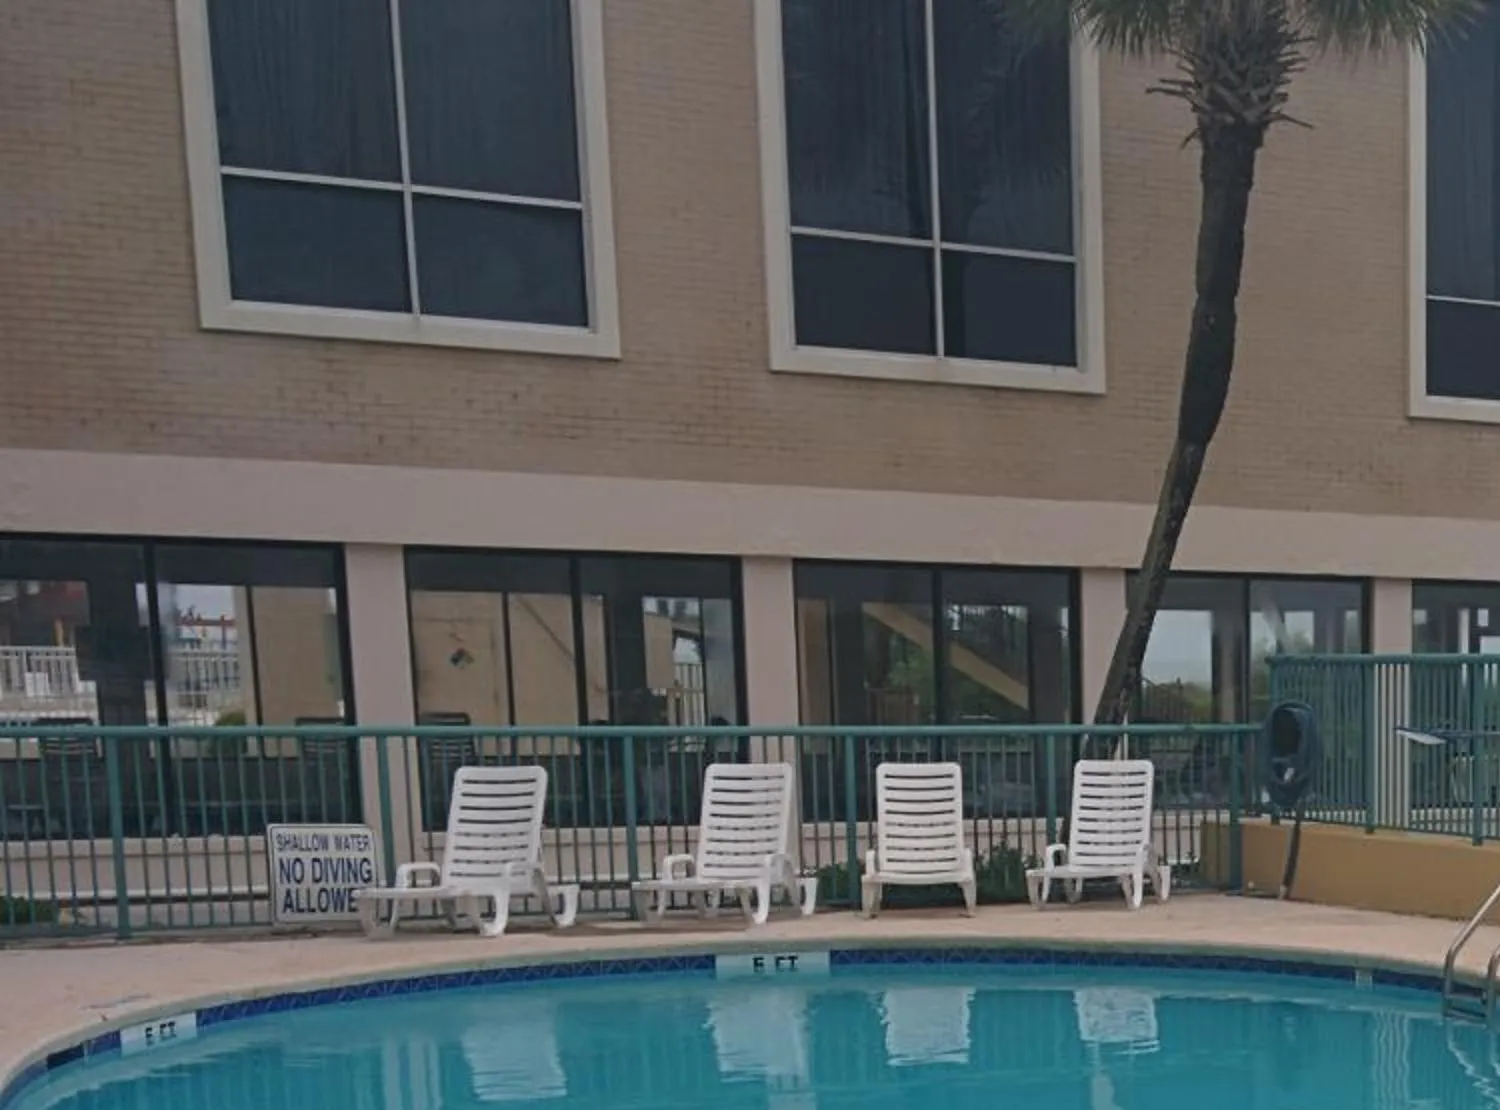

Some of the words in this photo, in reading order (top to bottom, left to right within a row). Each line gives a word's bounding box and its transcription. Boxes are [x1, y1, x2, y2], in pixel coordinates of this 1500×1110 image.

[276, 833, 329, 851] SHALLOW
[334, 833, 370, 851] WATER
[280, 857, 304, 884] NO
[311, 857, 372, 884] DIVING
[283, 887, 359, 913] ALLOWE
